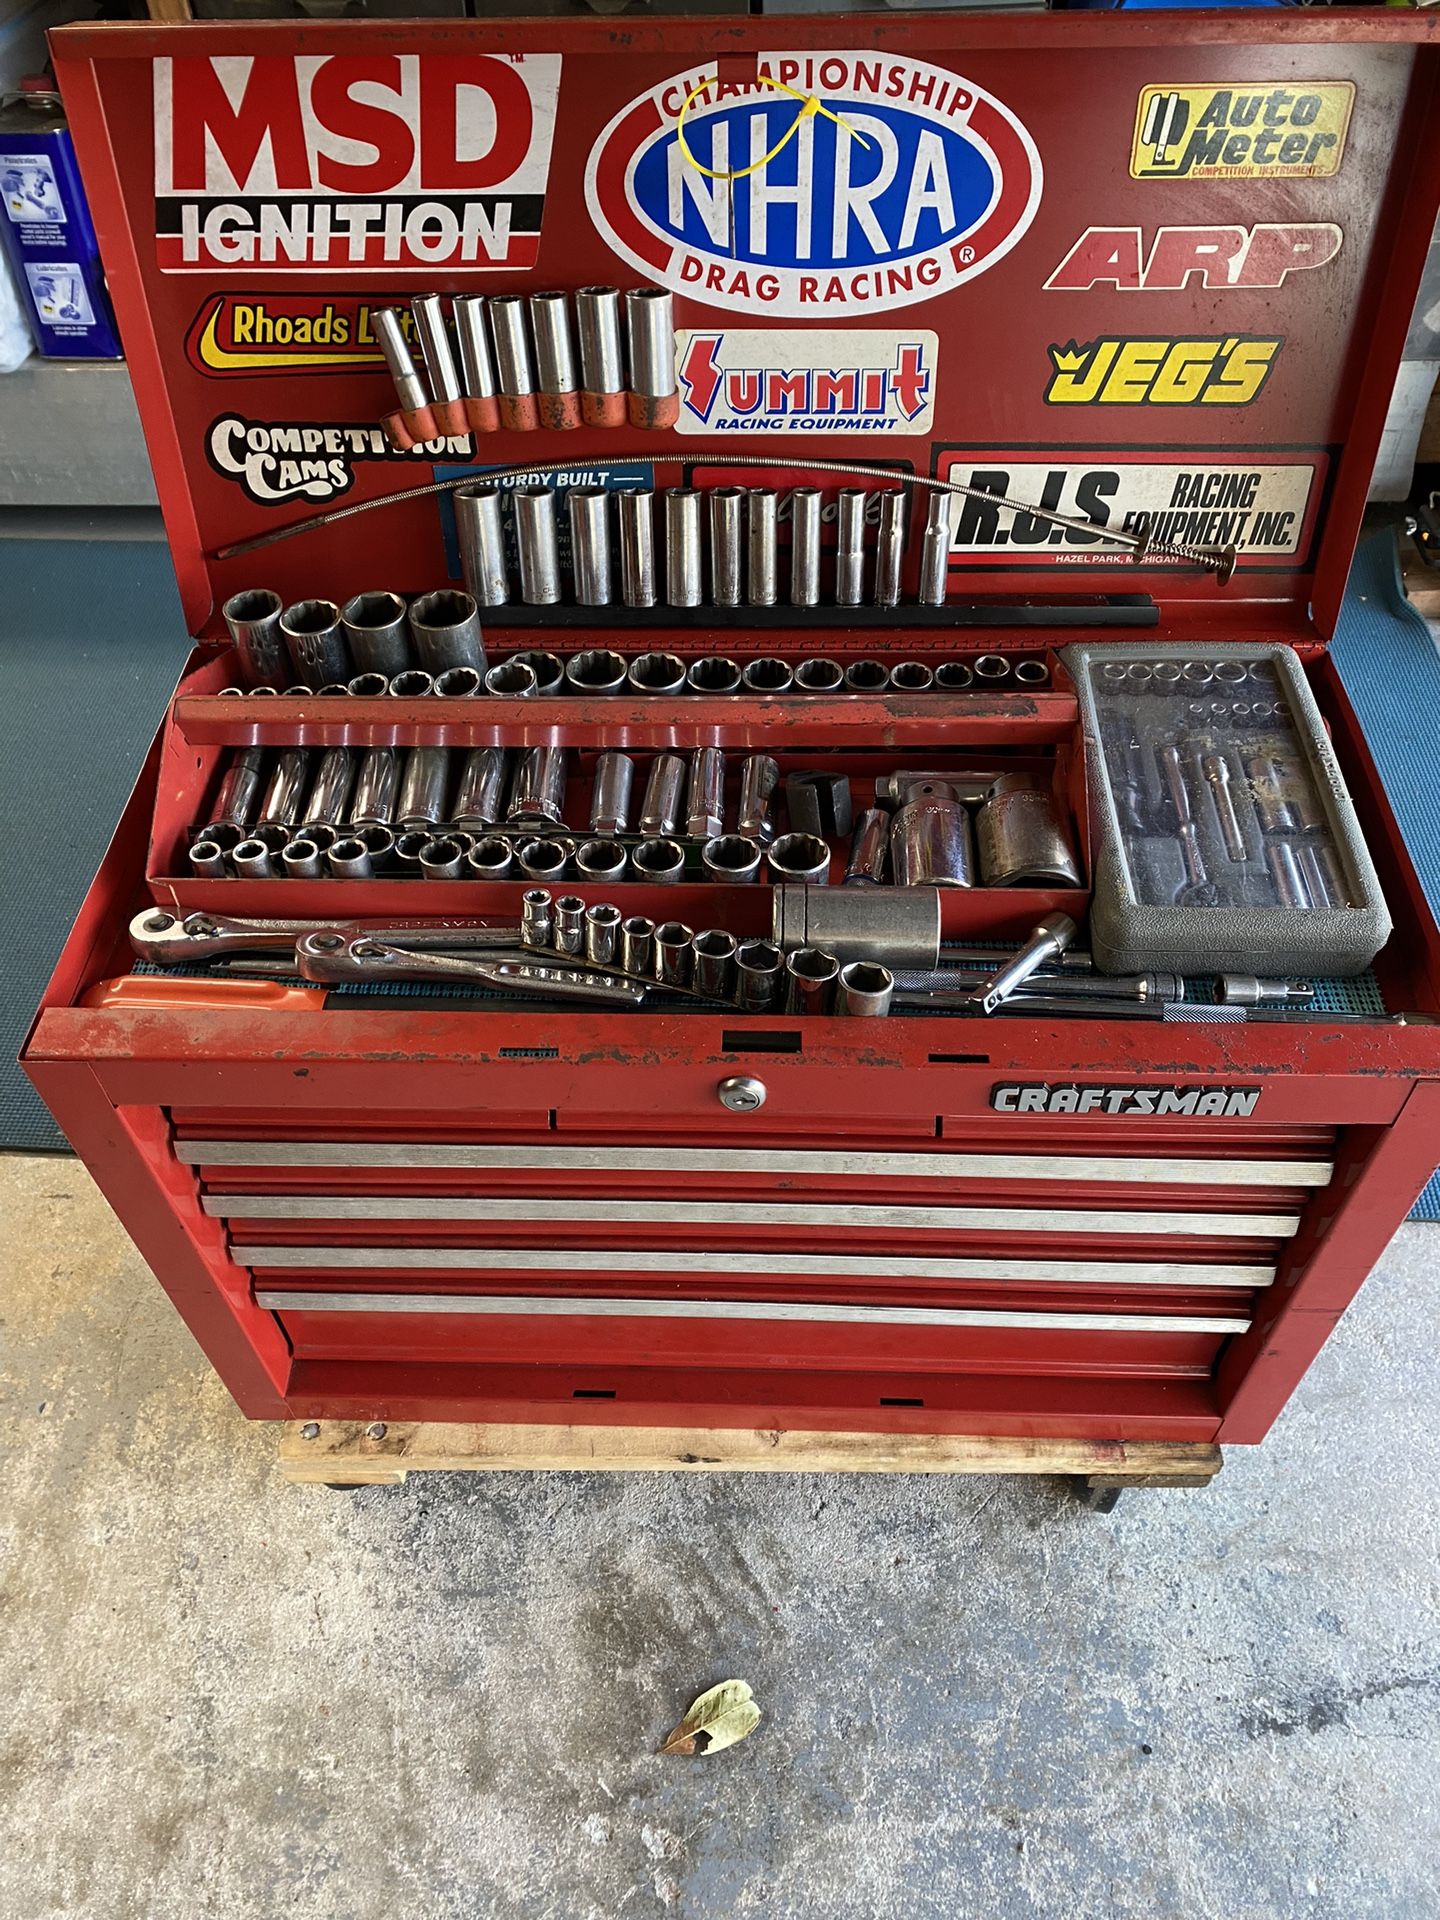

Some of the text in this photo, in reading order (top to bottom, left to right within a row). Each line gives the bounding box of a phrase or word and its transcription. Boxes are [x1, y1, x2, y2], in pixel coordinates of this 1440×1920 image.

[171, 54, 534, 194] MSD
[1195, 89, 1323, 128] Auto
[1182, 128, 1338, 167] Meter
[666, 110, 957, 259] NHRA
[1192, 165, 1254, 177] COMPETITION
[181, 202, 513, 263] IGNITION
[1042, 223, 1344, 290] ARP
[680, 254, 942, 302] DRAG RACING
[233, 305, 349, 344] Rhoads
[1047, 338, 1279, 402] JEG'S
[715, 418, 898, 430] RACING EQUIPMENT
[211, 419, 471, 473] COMPETION
[246, 452, 350, 500] CAMS
[480, 472, 610, 488] URDY BUILT
[1169, 473, 1262, 509] RACING
[1055, 555, 1179, 565] HAZEL PARK, MHIGAN
[993, 1084, 1262, 1117] CRAFTSMAN
